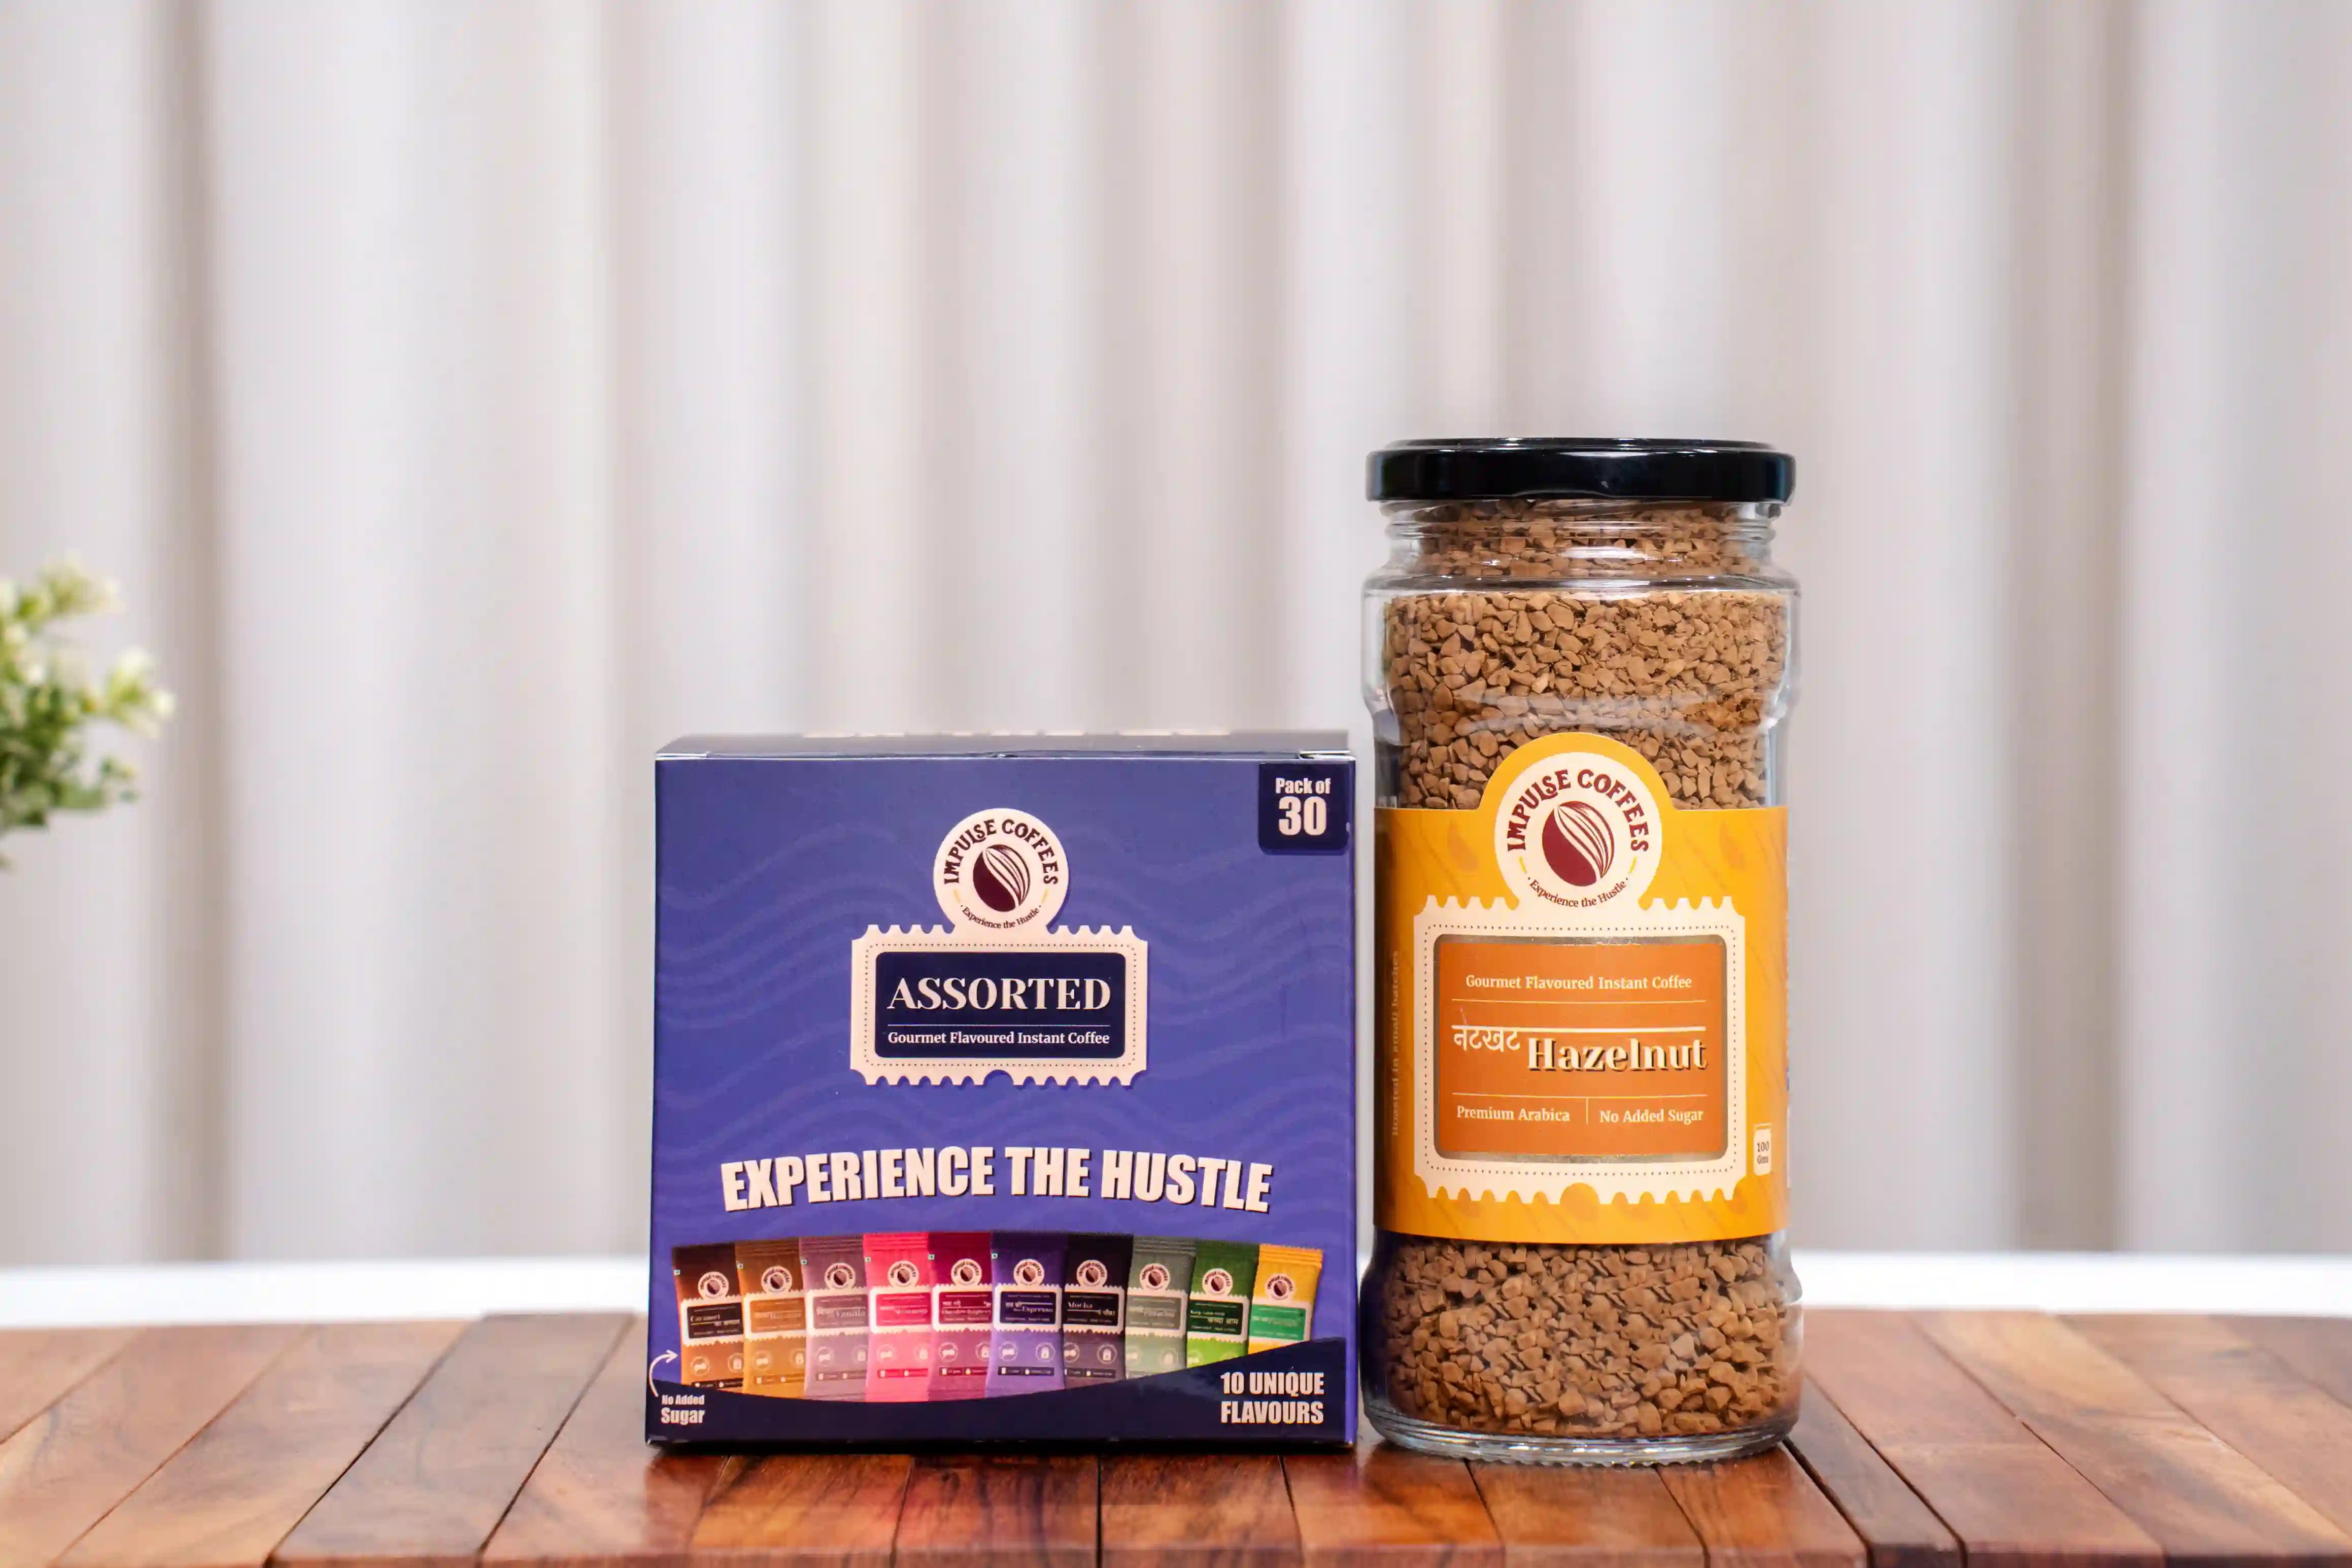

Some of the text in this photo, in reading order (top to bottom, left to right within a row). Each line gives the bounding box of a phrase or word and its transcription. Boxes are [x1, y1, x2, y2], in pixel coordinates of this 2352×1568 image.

[1275, 777, 1331, 794] Pack of
[1278, 796, 1326, 835] 30
[1507, 769, 1649, 852] IMPULSE COFFEES
[944, 819, 1059, 885] IMPULSE COFFEES
[1529, 879, 1626, 907] Experience the Hustle
[962, 906, 1002, 929] Experience
[1016, 908, 1040, 925] Hustle
[887, 977, 1111, 1010] ASSORTED
[1466, 975, 1692, 989] Gourmet Flavoured Instant Coffee
[888, 1031, 1110, 1044] Gourmet Flavoured Instant Coffee
[1452, 1025, 1521, 1052] नटखट
[1527, 1037, 1709, 1073] Hazelnut
[1457, 1105, 1571, 1121] Premium Arabica
[1600, 1109, 1704, 1125] No Added Sugar
[1757, 1141, 1769, 1152] 100
[721, 1146, 1273, 1214] EXPERIENCE THE HUSTLE
[1220, 1372, 1324, 1397] 10 UNIQUE
[662, 1394, 705, 1405] No Added
[661, 1407, 705, 1425] Sugar
[1221, 1401, 1324, 1424] FLAVOURS
